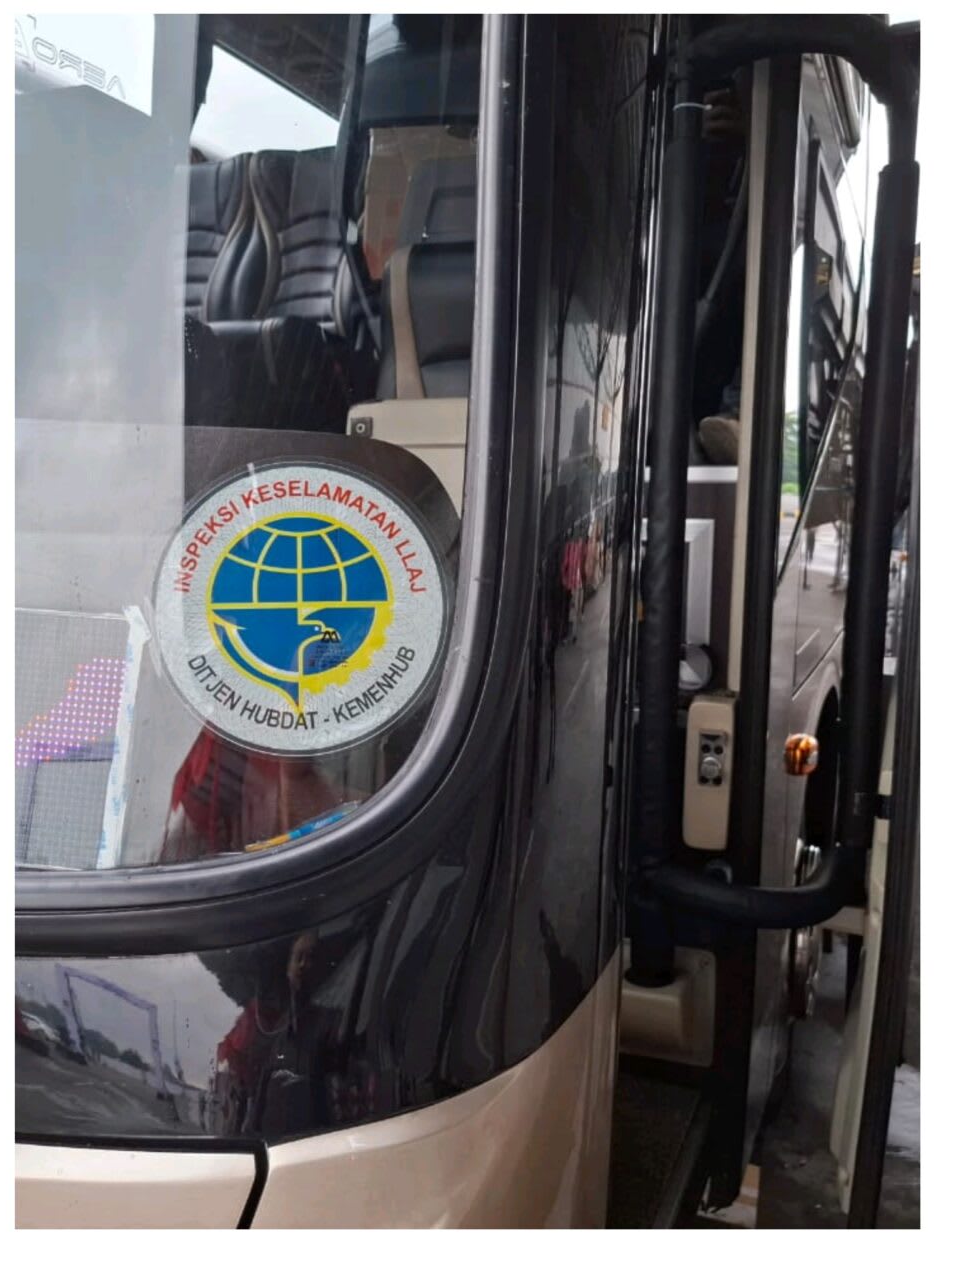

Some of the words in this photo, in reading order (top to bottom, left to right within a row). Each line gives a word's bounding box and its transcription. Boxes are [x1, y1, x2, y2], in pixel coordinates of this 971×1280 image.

[174, 499, 240, 594] INSPEKSI
[240, 479, 402, 541] KESELAMATAN
[394, 535, 428, 595] LLAJ
[239, 700, 319, 731] HUBDAT
[334, 645, 417, 724] KEMENHUB
